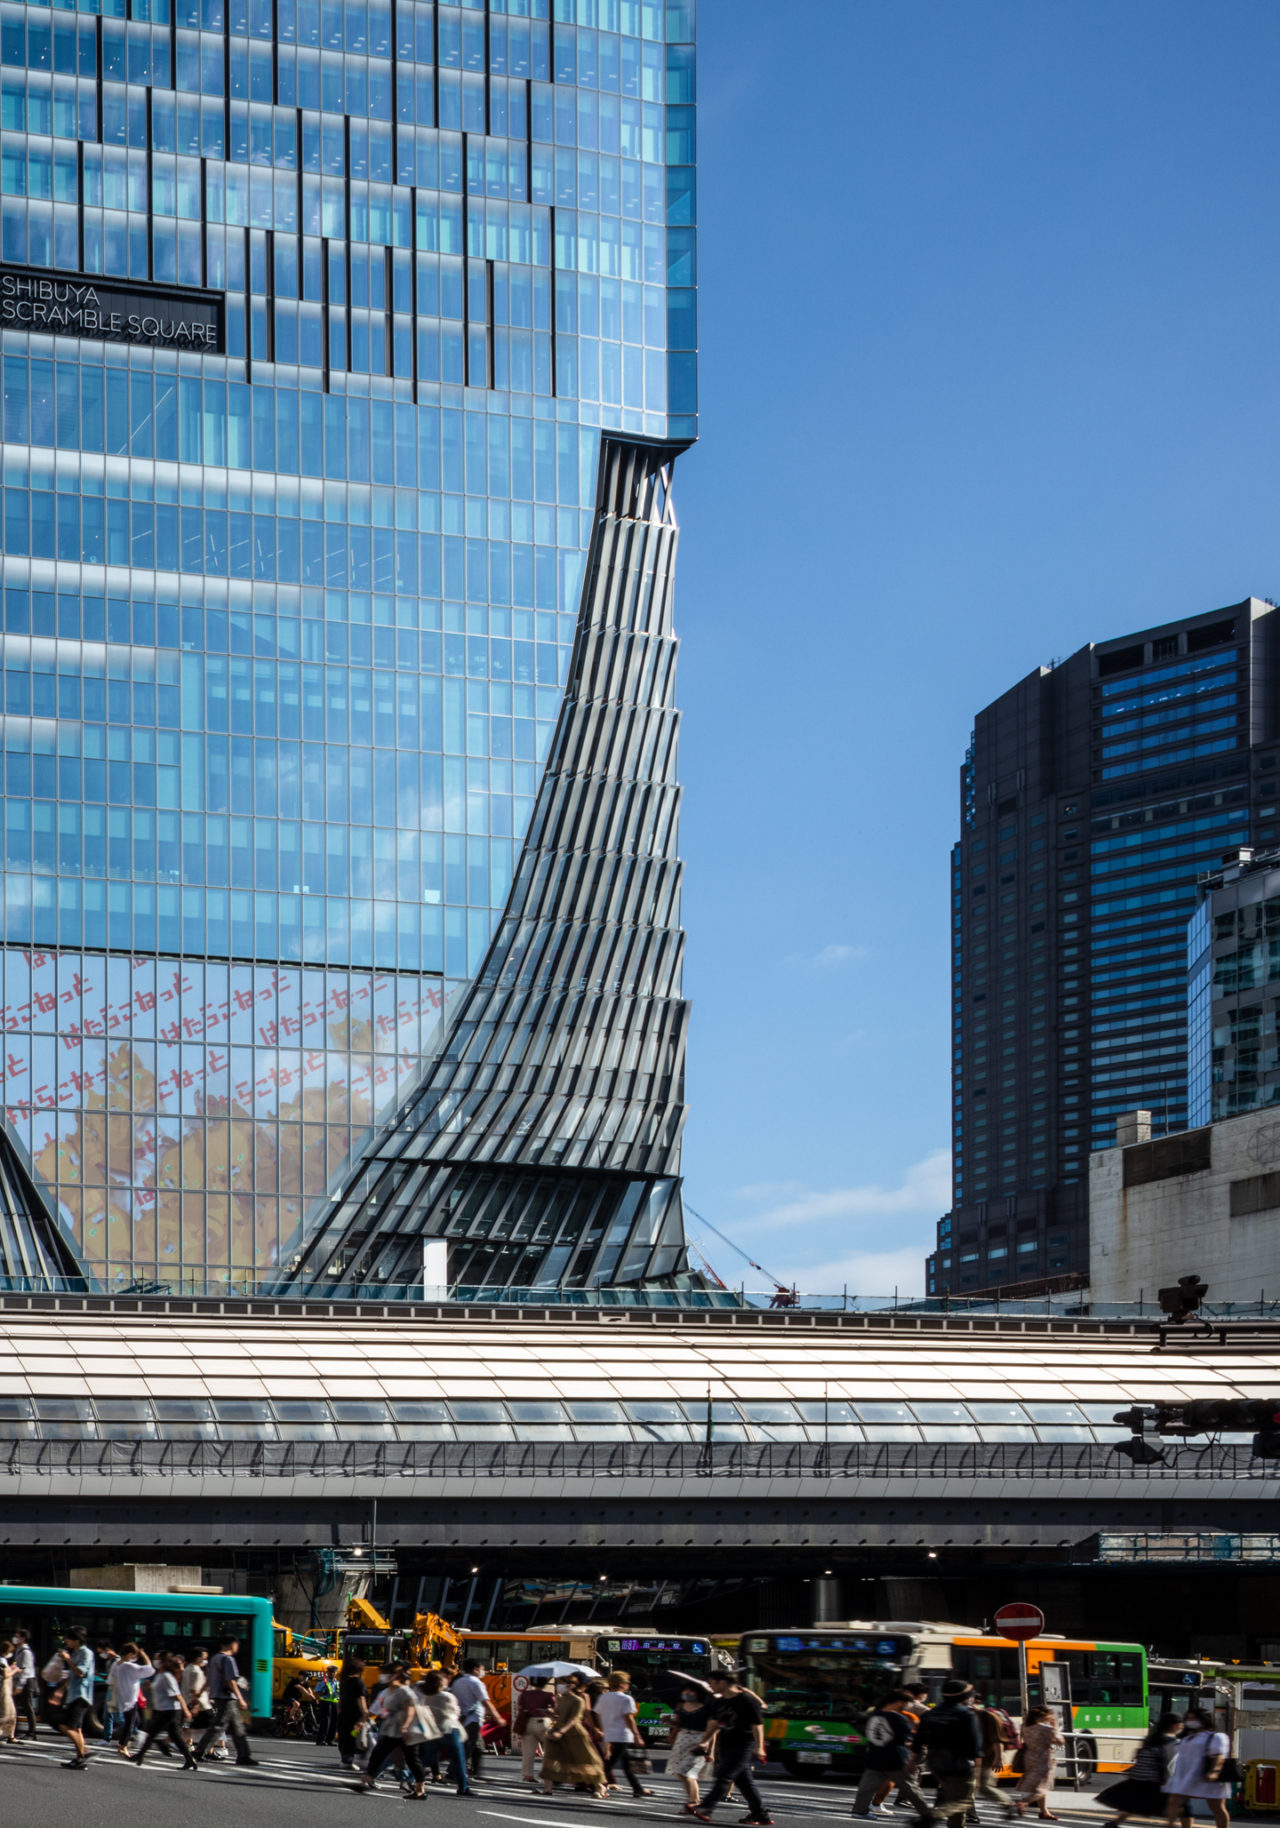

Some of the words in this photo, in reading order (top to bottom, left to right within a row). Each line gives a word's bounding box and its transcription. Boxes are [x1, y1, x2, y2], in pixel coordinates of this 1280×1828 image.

[2, 276, 100, 306] SHIBUYA
[2, 299, 121, 333] SCRAMBLE
[128, 315, 216, 344] SQUARE
